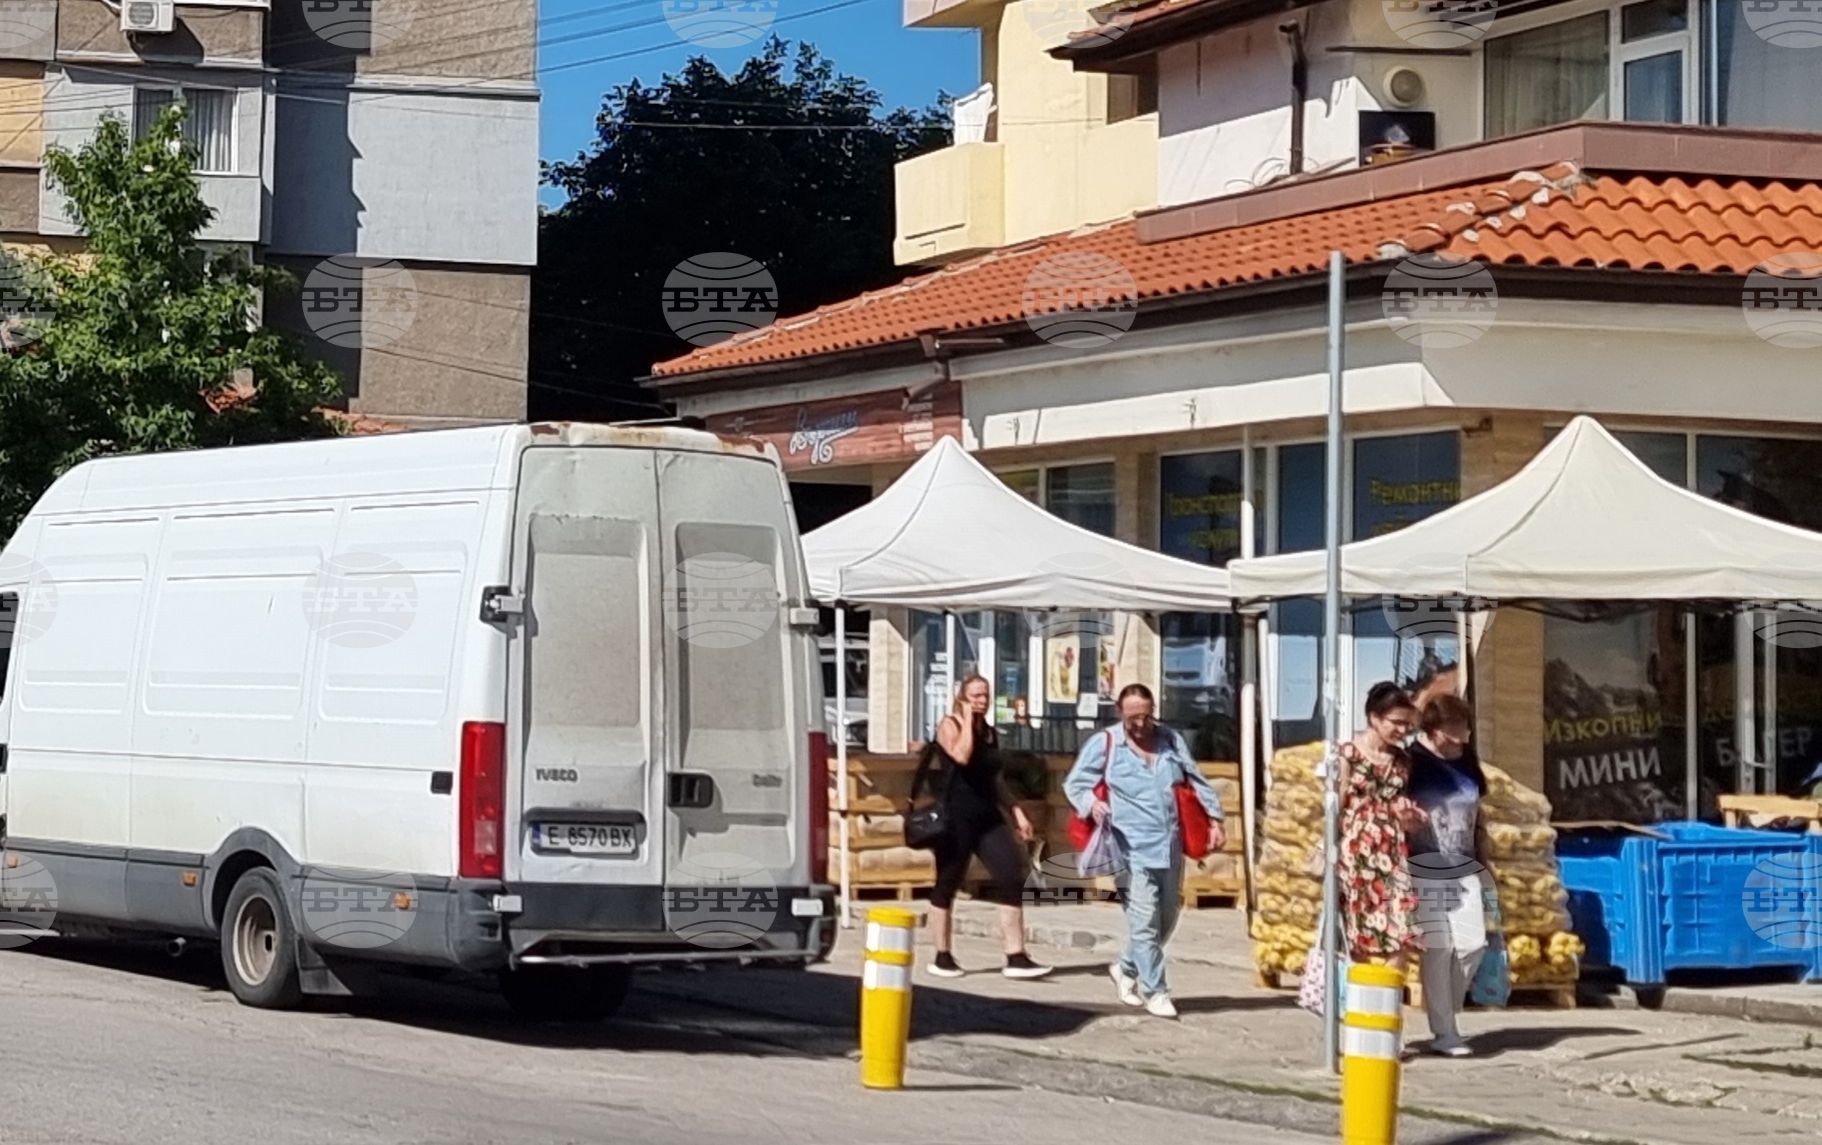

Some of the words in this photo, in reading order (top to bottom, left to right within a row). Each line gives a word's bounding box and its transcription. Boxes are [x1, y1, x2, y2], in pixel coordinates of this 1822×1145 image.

[1543, 710, 1663, 745] Изкопни
[1715, 726, 1813, 768] БЕР
[535, 768, 578, 783] IVECO
[1558, 746, 1663, 791] МИНИ
[548, 826, 559, 845] E
